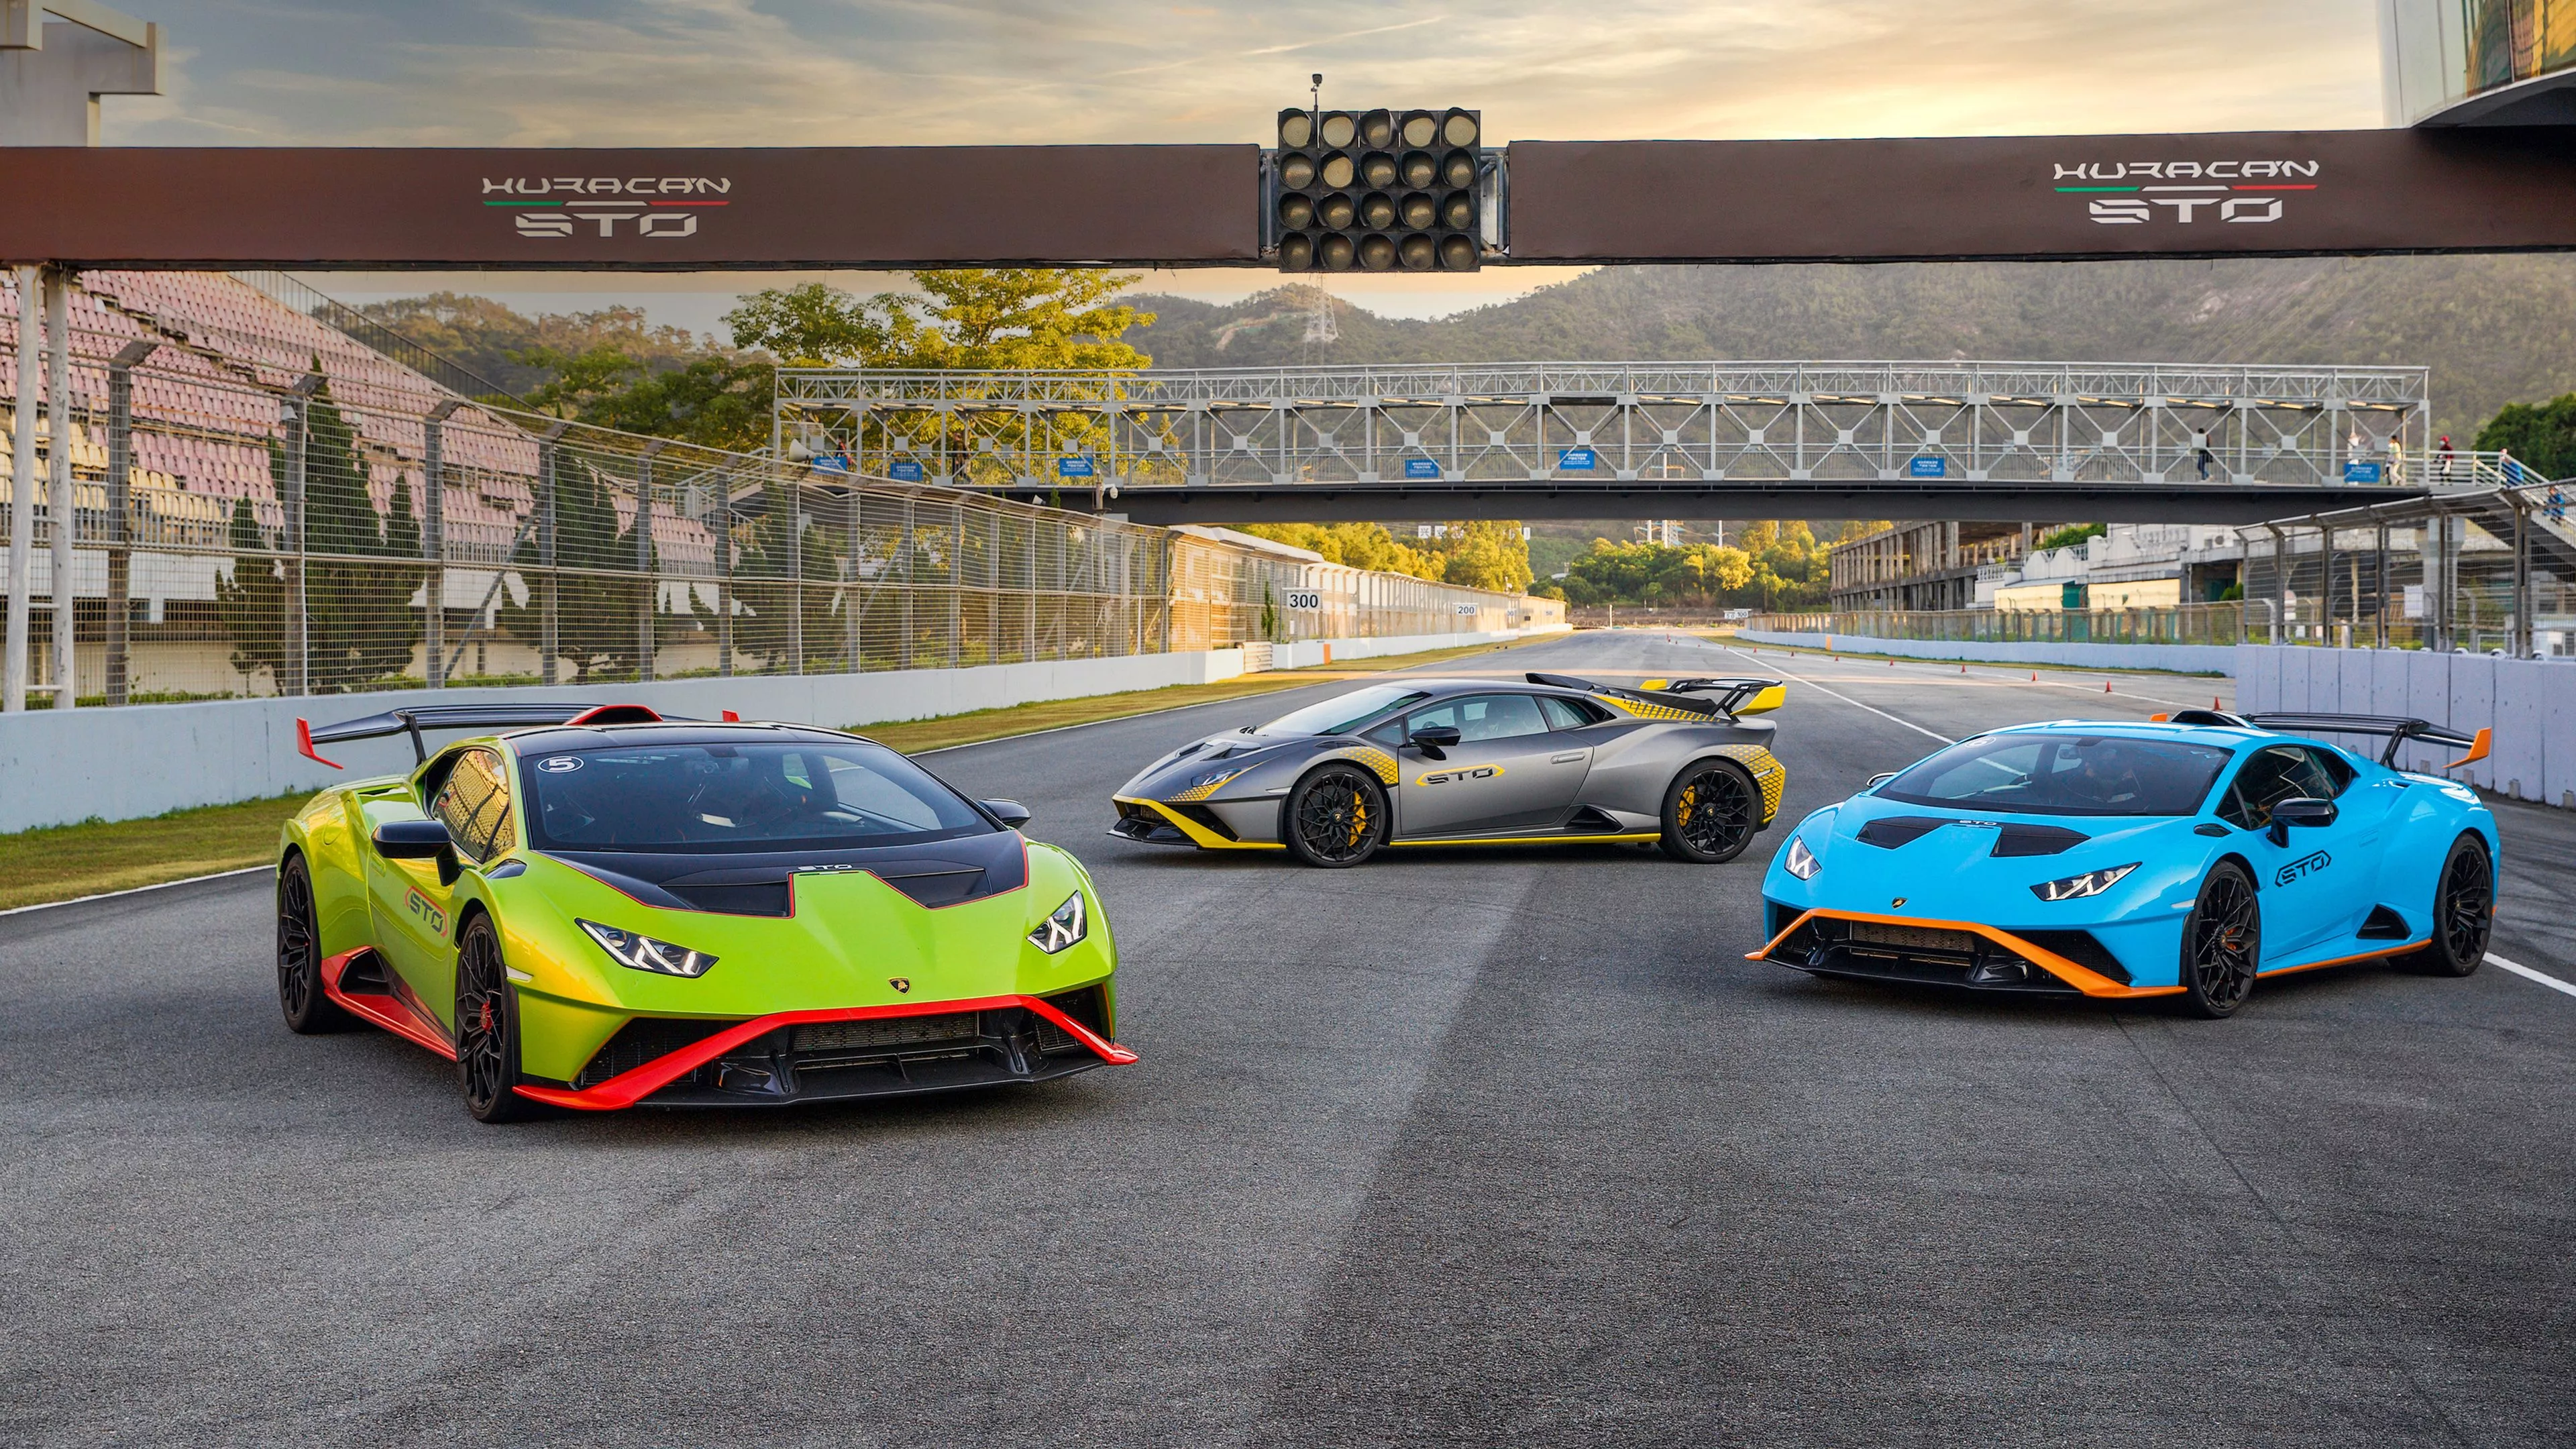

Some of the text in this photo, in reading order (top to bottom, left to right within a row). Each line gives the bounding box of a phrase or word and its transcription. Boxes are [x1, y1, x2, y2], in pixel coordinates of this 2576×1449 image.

[2090, 198, 2282, 223] STO
[515, 213, 697, 237] STO
[1289, 594, 1318, 608] 300
[1458, 606, 1474, 614] 200
[549, 758, 575, 771] 5
[1427, 768, 1493, 784] STO
[2282, 855, 2325, 884] STO
[409, 892, 443, 933] STO
